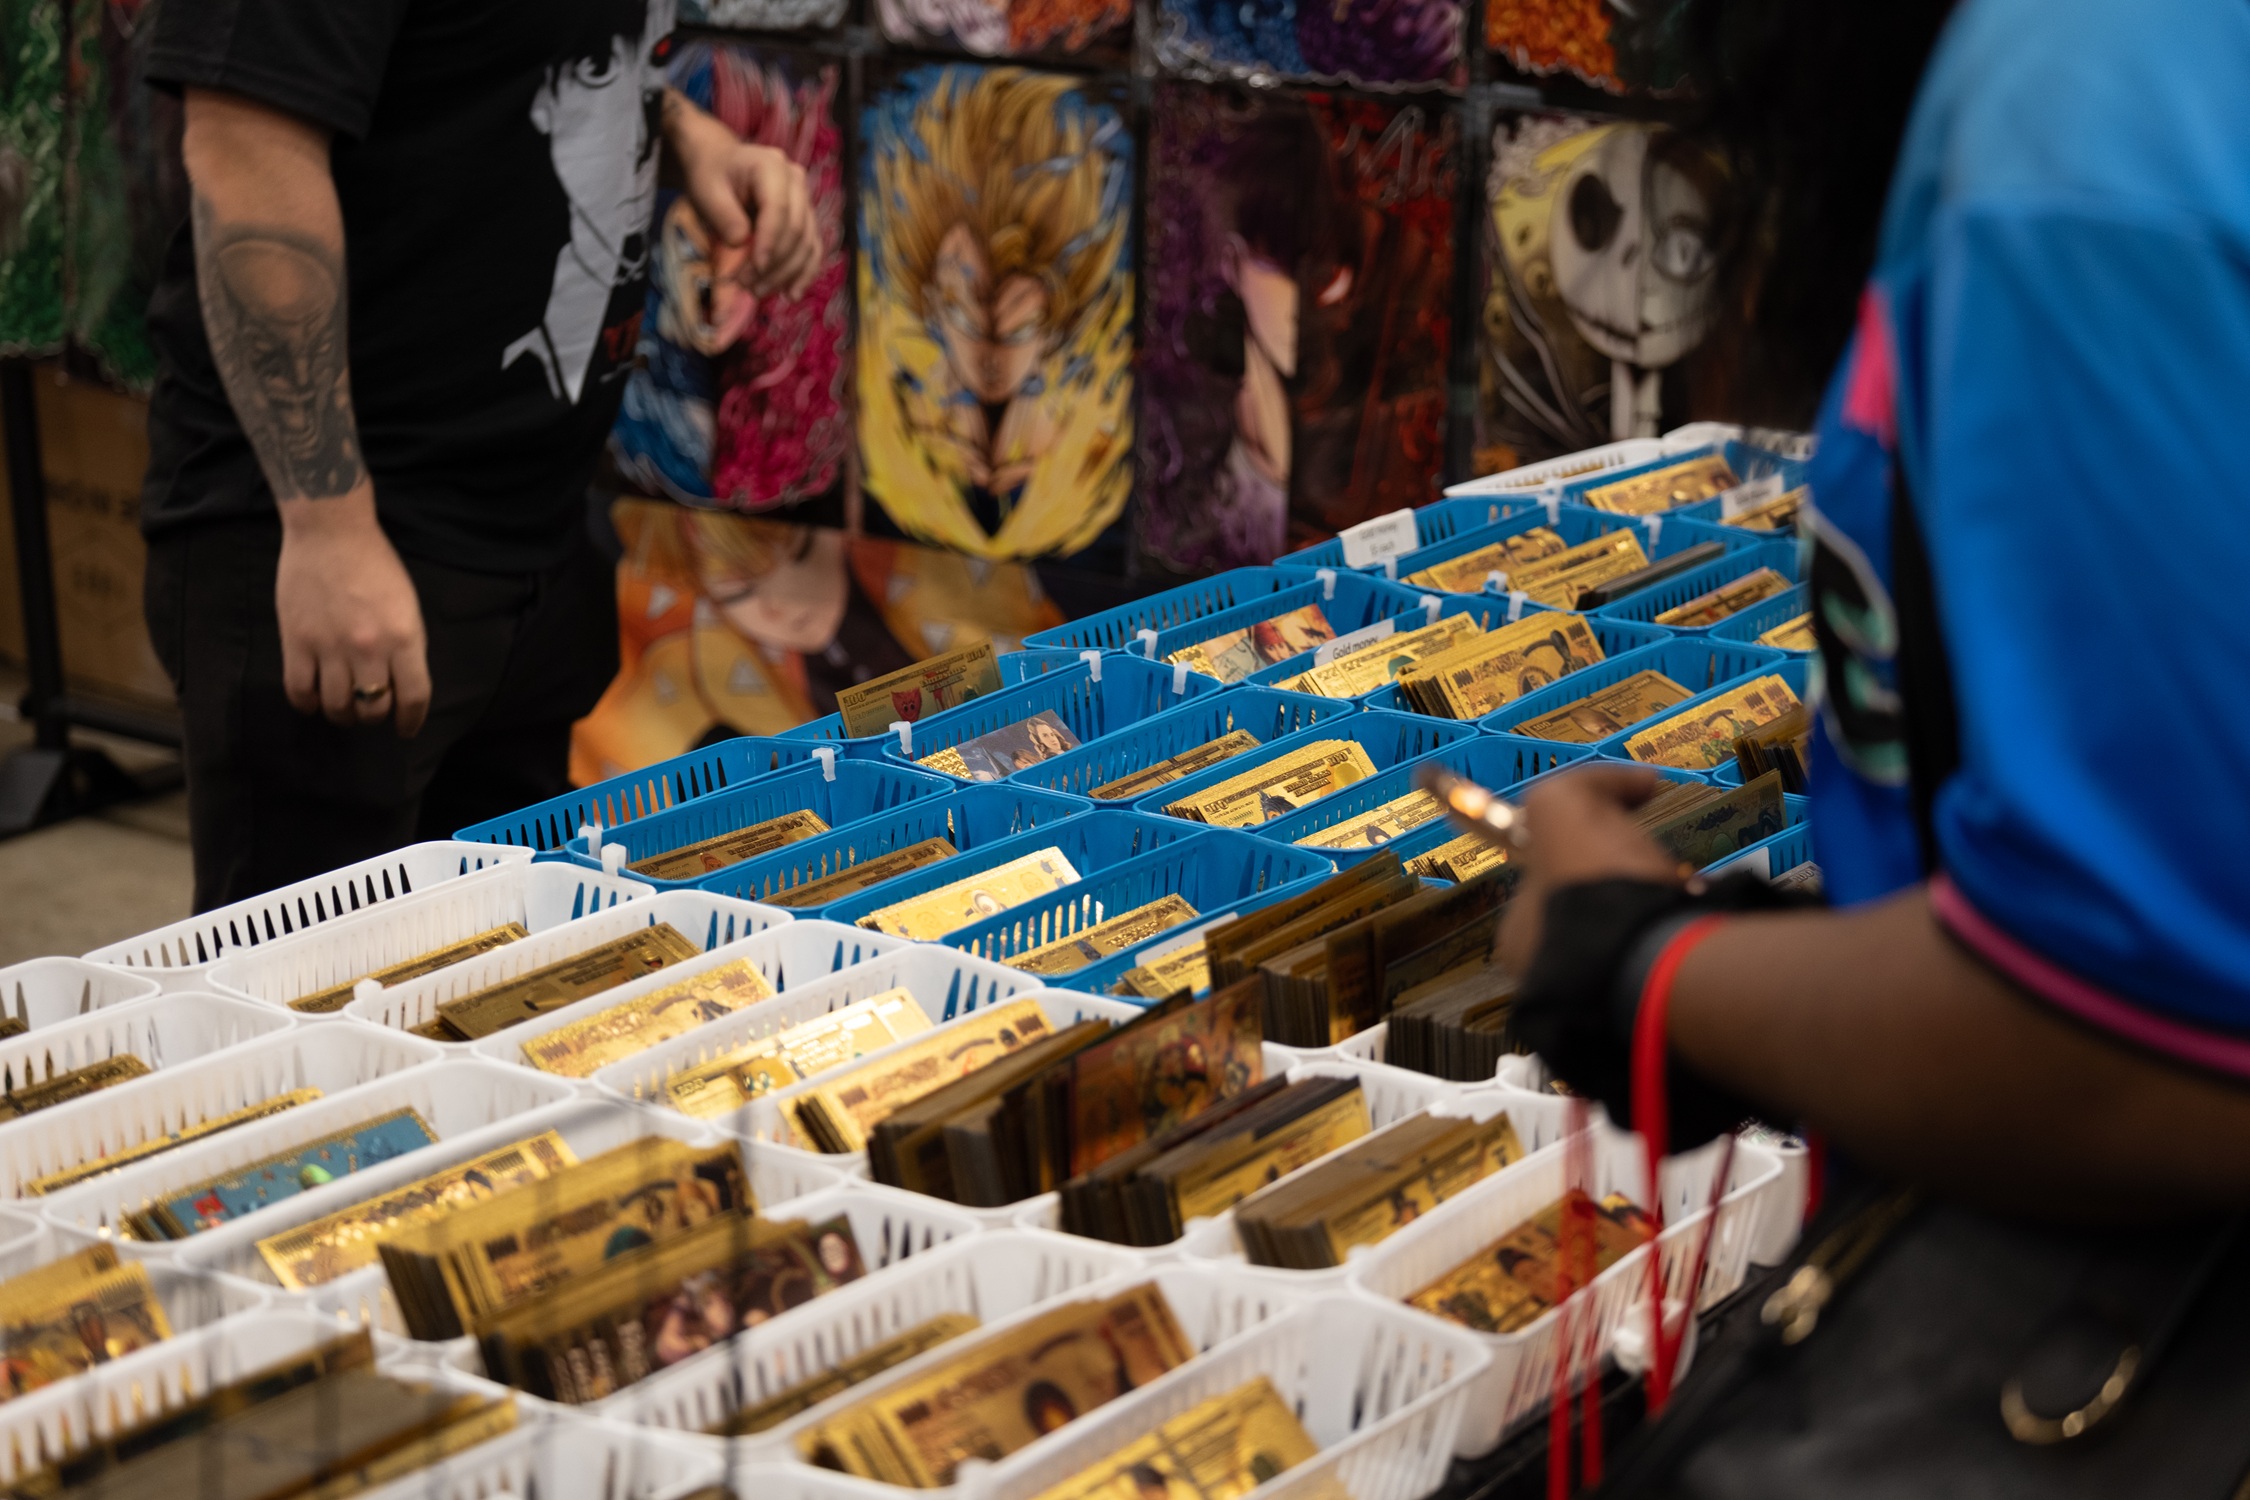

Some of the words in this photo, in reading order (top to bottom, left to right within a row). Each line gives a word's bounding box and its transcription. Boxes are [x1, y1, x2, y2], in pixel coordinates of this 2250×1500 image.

[965, 647, 986, 663] 100
[1332, 642, 1351, 659] Gold
[1353, 636, 1378, 651] money
[846, 690, 867, 706] 100
[1456, 850, 1478, 867] 100
